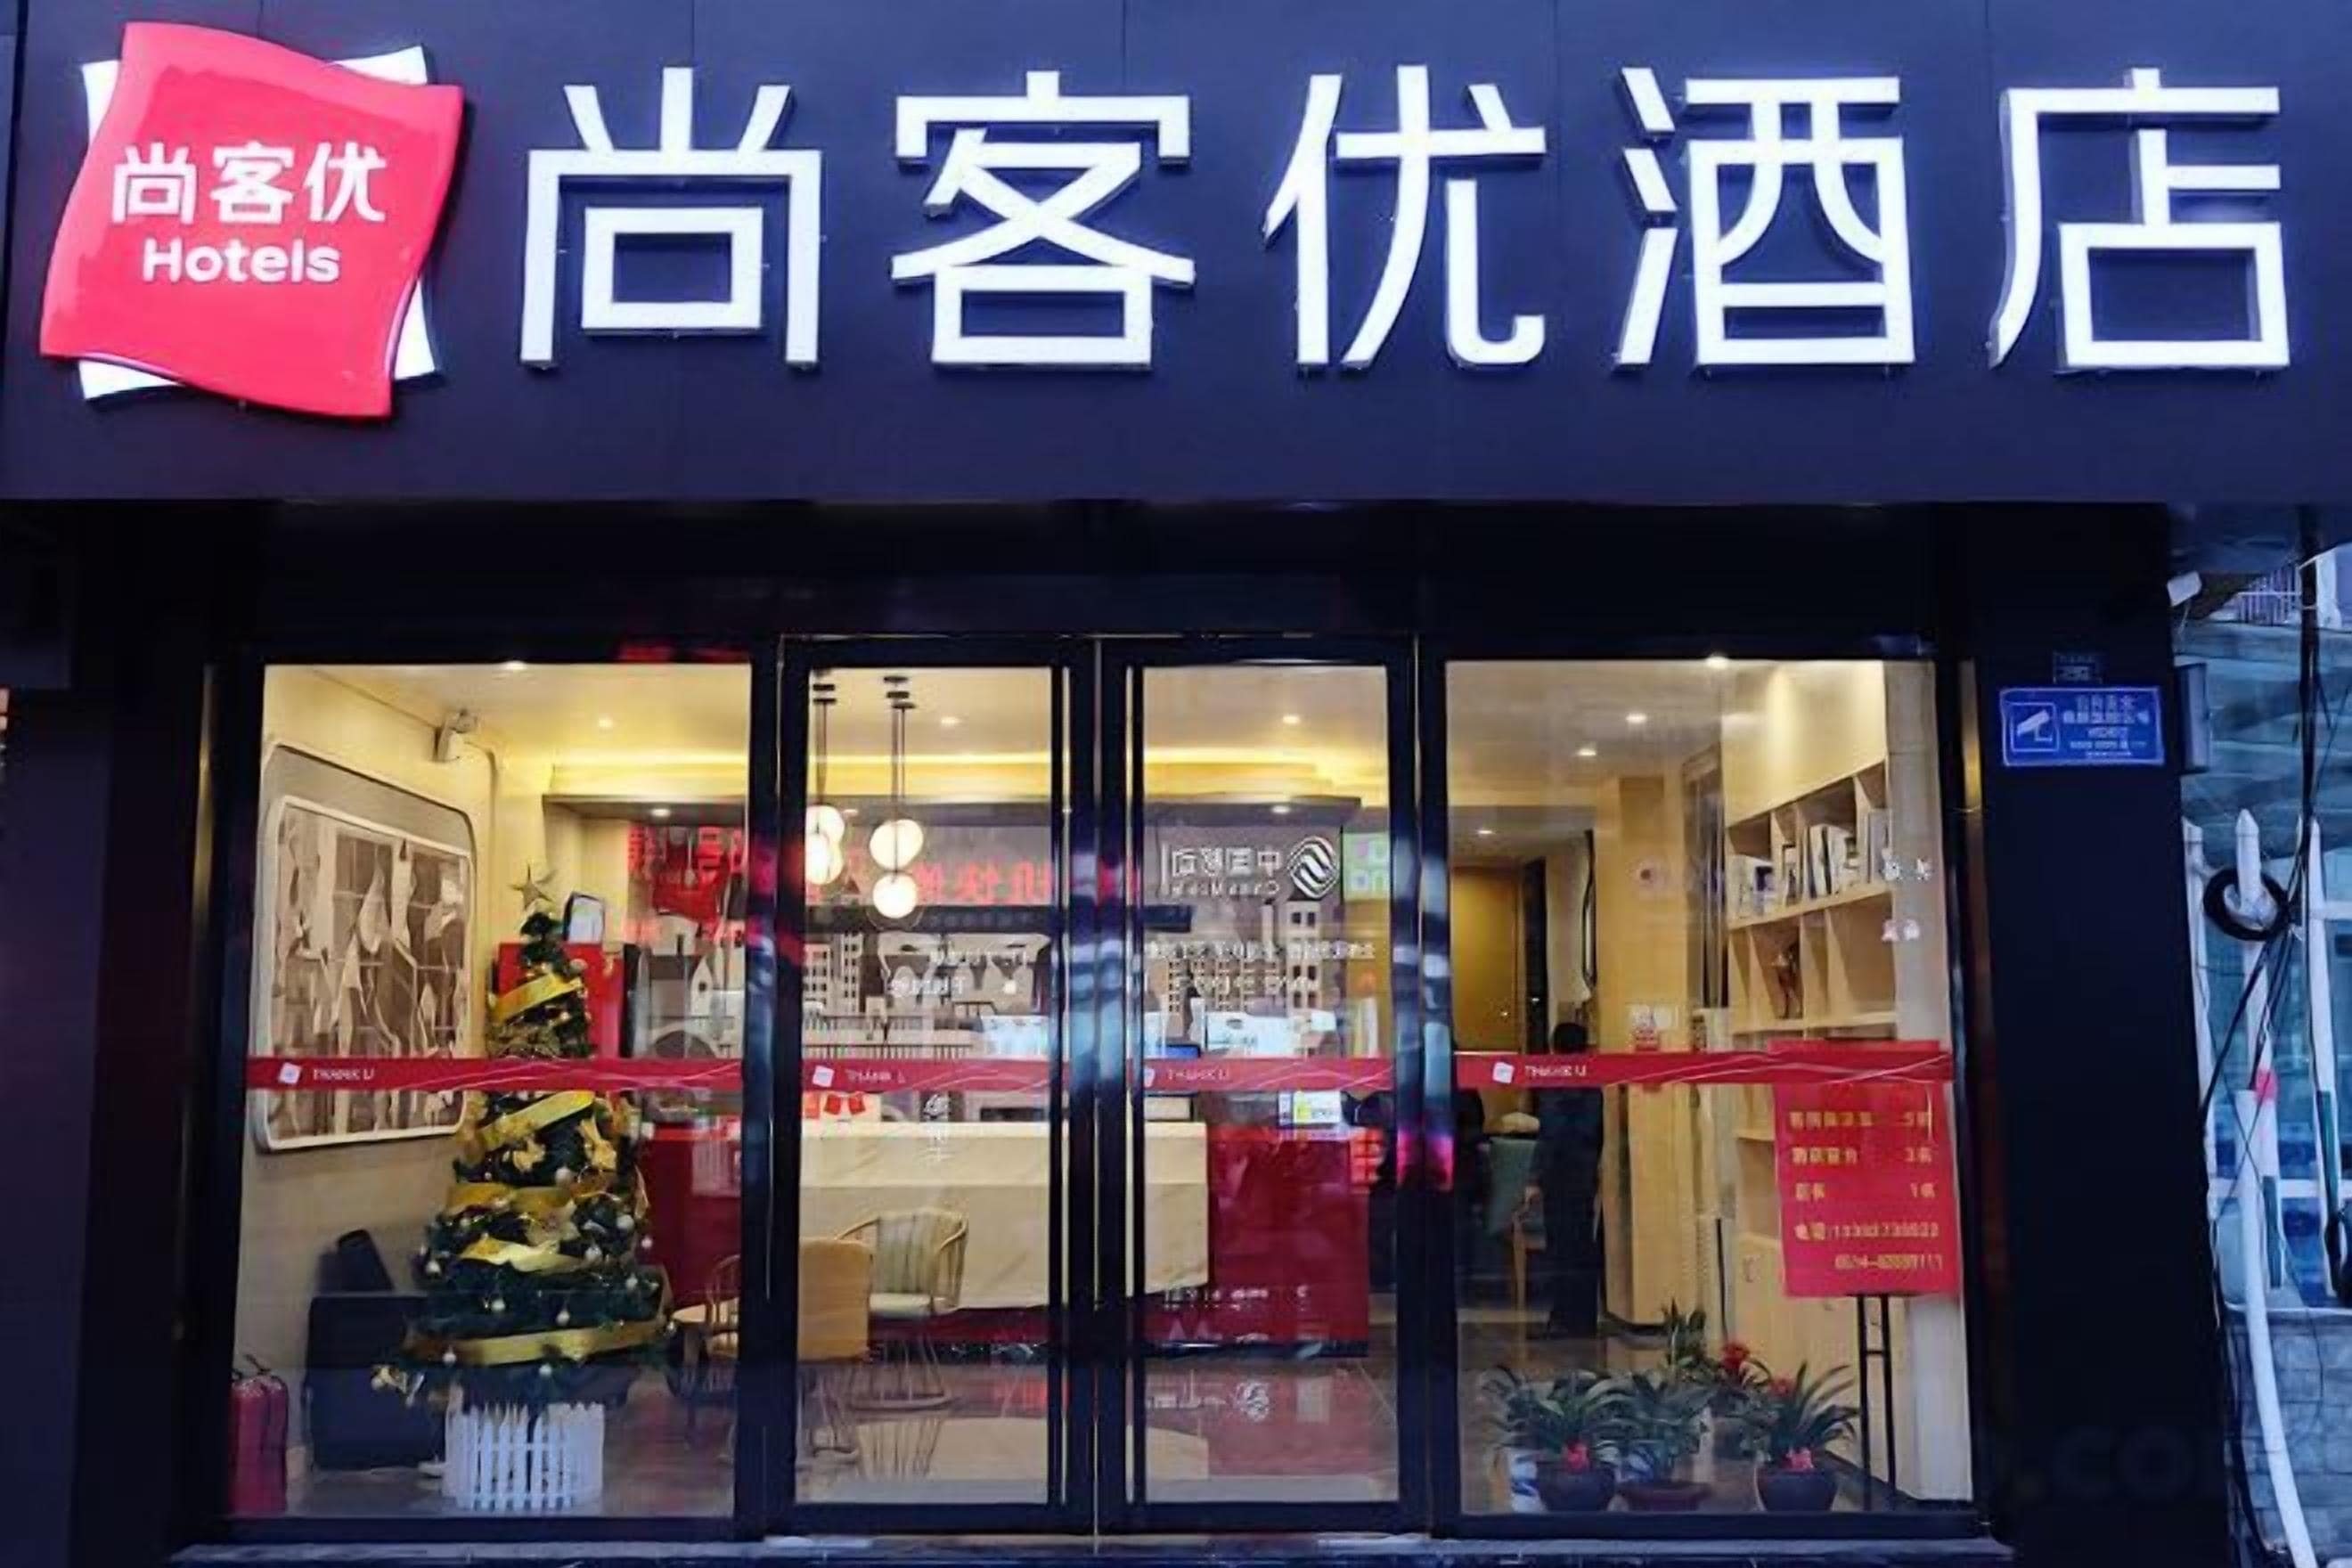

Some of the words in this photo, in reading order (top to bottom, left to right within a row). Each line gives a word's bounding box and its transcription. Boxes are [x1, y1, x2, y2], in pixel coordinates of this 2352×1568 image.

[110, 142, 388, 225] 尚客优
[519, 64, 2291, 372] 尚客优酒店
[142, 236, 342, 284] Hotels
